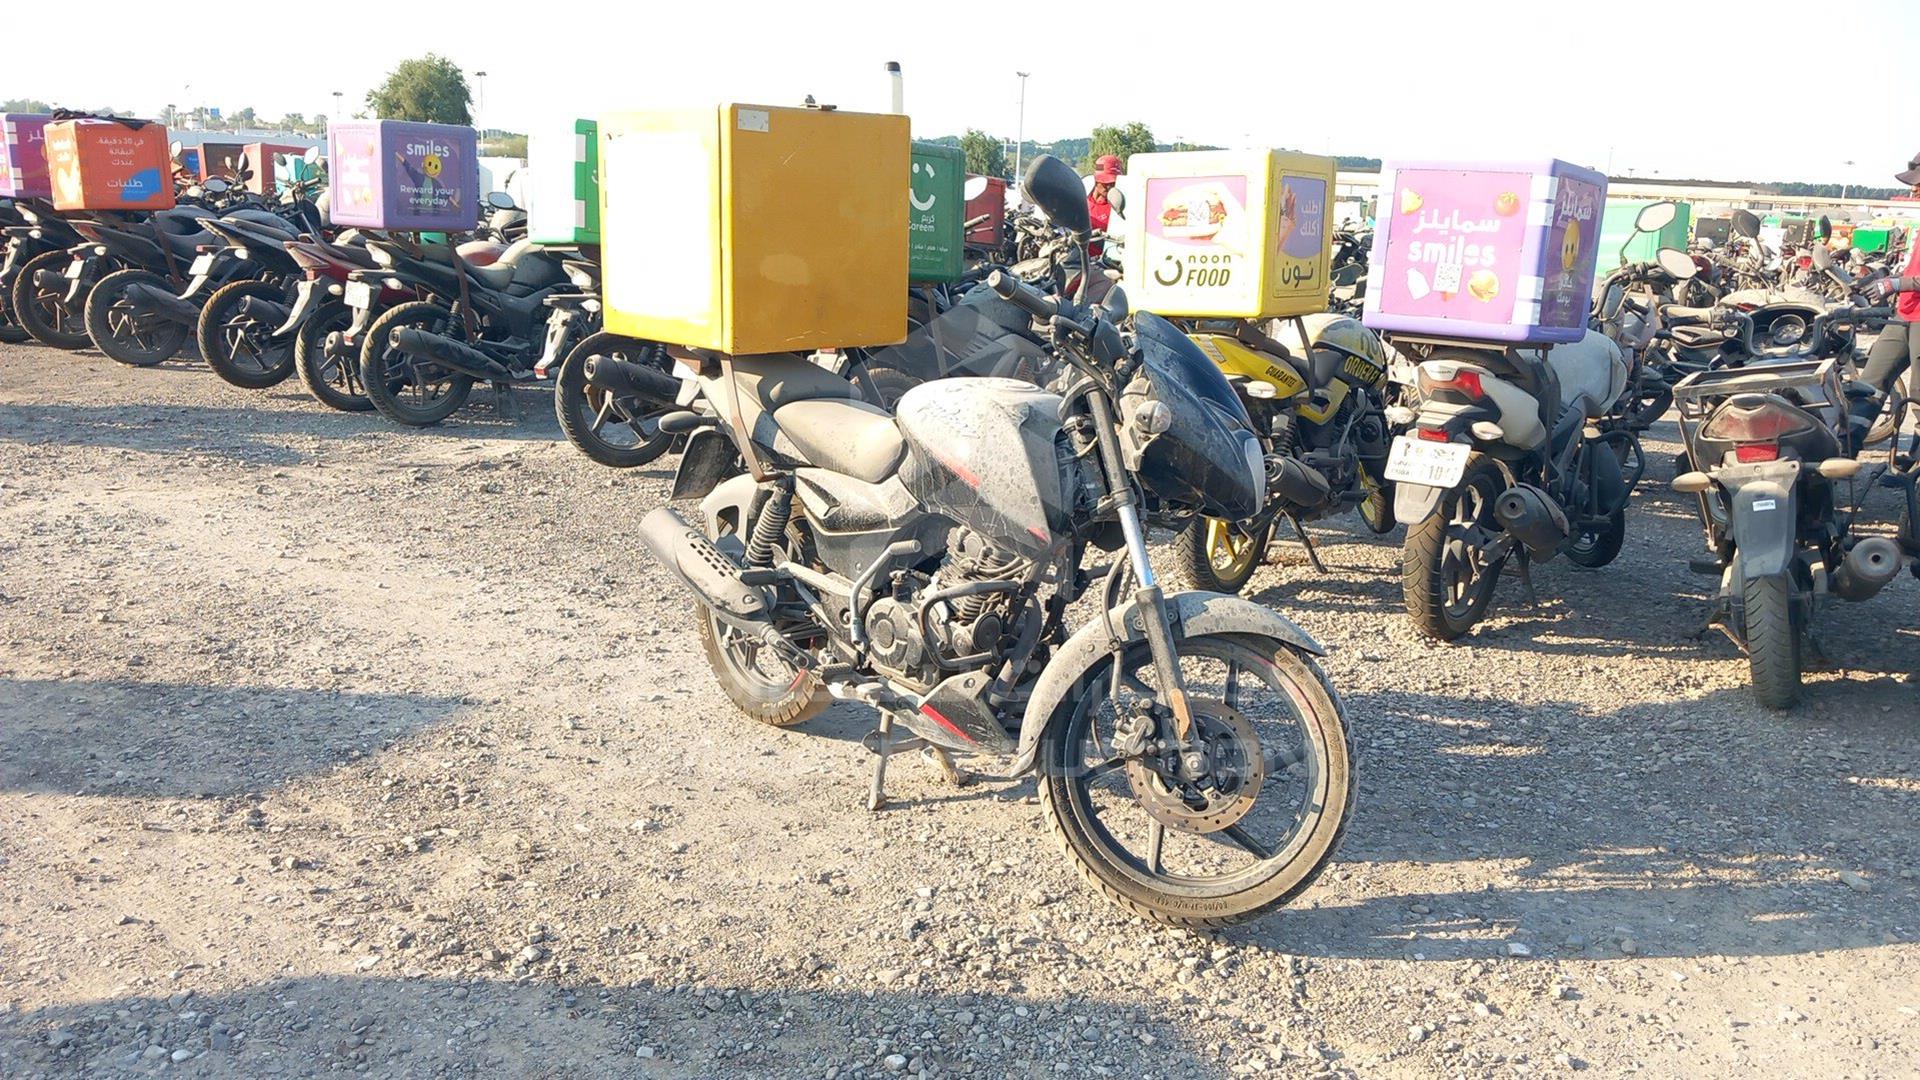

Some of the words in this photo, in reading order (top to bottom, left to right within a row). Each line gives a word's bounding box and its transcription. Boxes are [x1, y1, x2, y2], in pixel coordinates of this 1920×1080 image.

[406, 140, 450, 157] smiles
[106, 178, 143, 189] طلبات
[400, 185, 433, 194] Reward
[435, 188, 454, 196] your
[409, 197, 448, 207] everyday
[1412, 209, 1500, 235] سمايلز
[1187, 254, 1232, 264] noon
[1408, 236, 1495, 266] smiles
[1186, 269, 1232, 287] FOOD
[1281, 260, 1314, 289] نون
[1265, 366, 1297, 388] GUARANTEE
